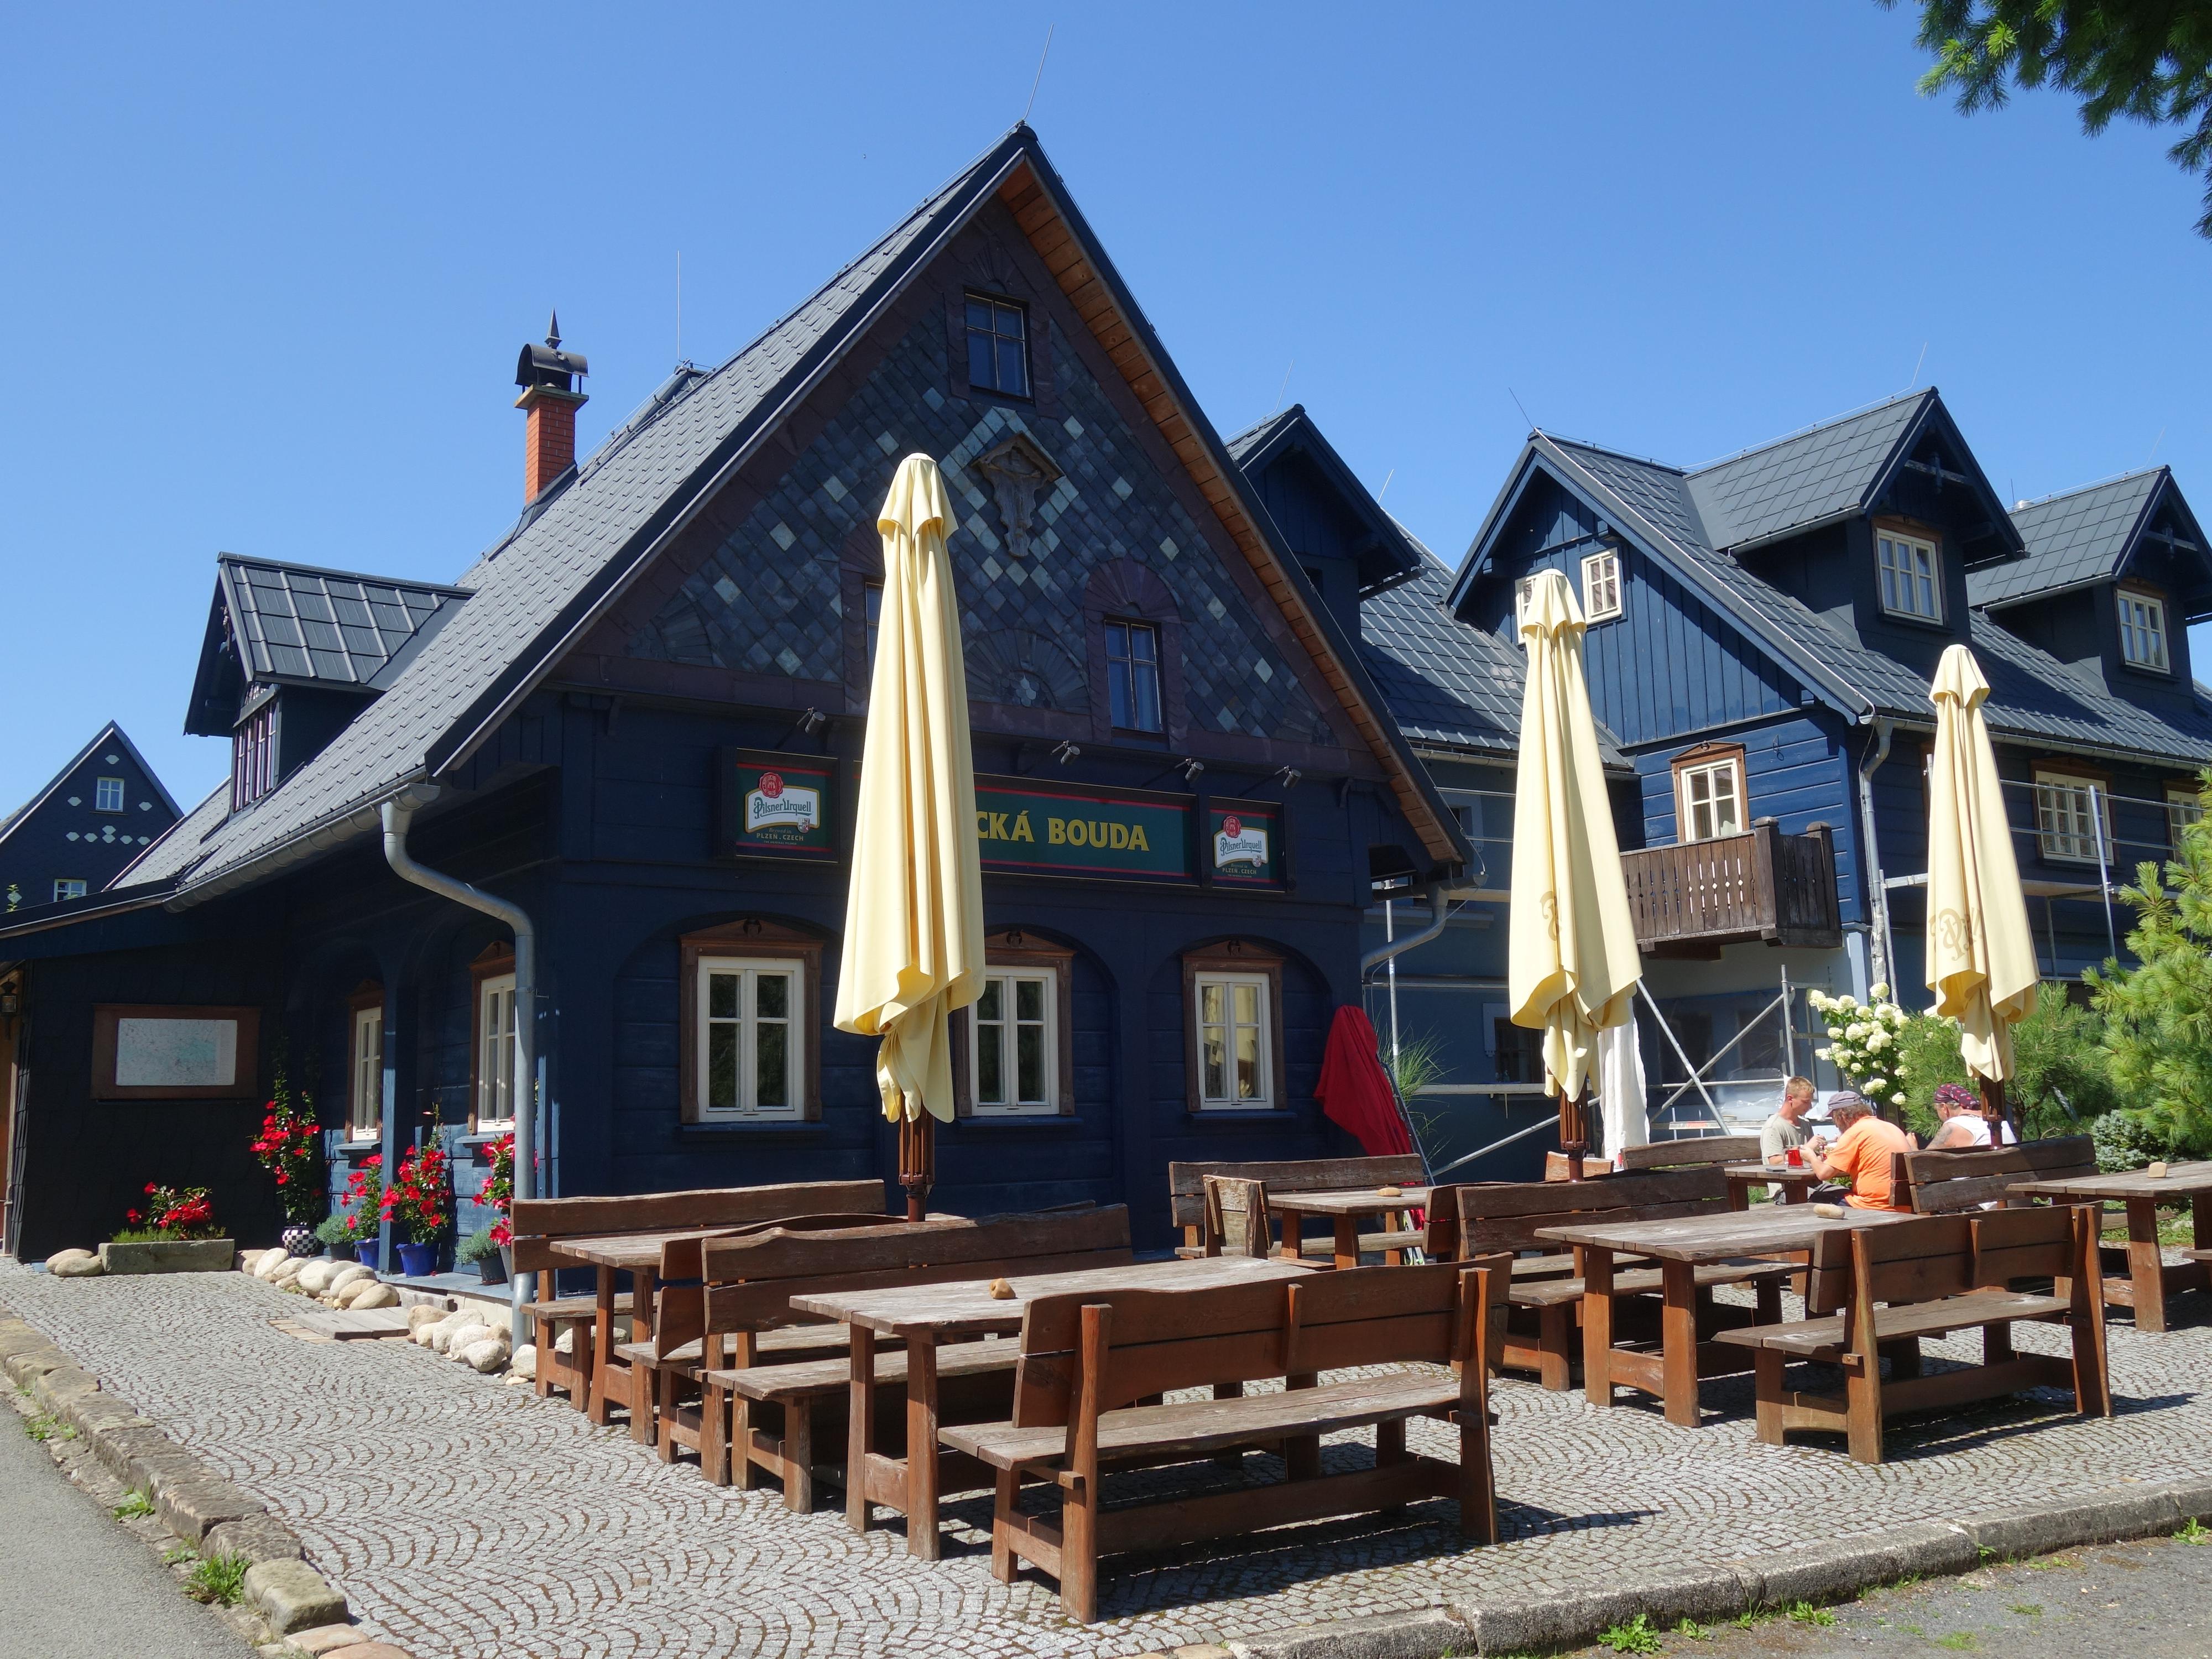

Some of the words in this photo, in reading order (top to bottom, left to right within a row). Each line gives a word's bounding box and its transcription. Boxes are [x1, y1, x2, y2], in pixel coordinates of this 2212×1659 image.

[754, 797, 783, 819] Pilsner
[782, 798, 811, 816] Urquell
[976, 810, 1035, 842] CKÁ
[1047, 817, 1150, 851] BOUDA
[1220, 837, 1241, 856] Pilsner
[1241, 838, 1262, 853] Urquell
